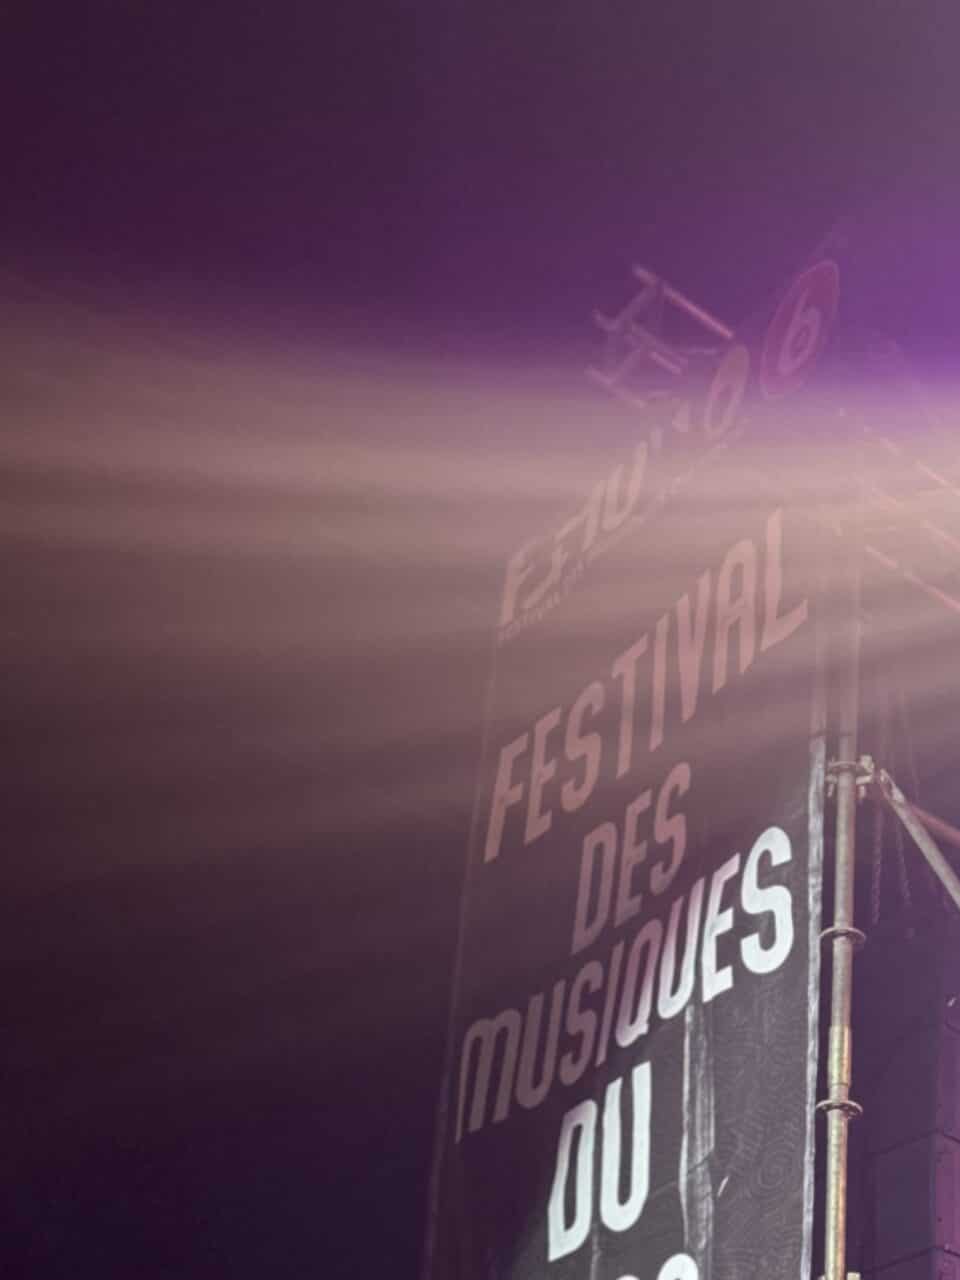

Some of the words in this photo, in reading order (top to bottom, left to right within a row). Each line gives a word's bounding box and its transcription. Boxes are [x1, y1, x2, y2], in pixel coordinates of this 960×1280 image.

[484, 506, 808, 862] FESTIVAL
[456, 826, 794, 1143] MUSIQUES
[571, 763, 691, 955] DES
[548, 1061, 651, 1262] DU
